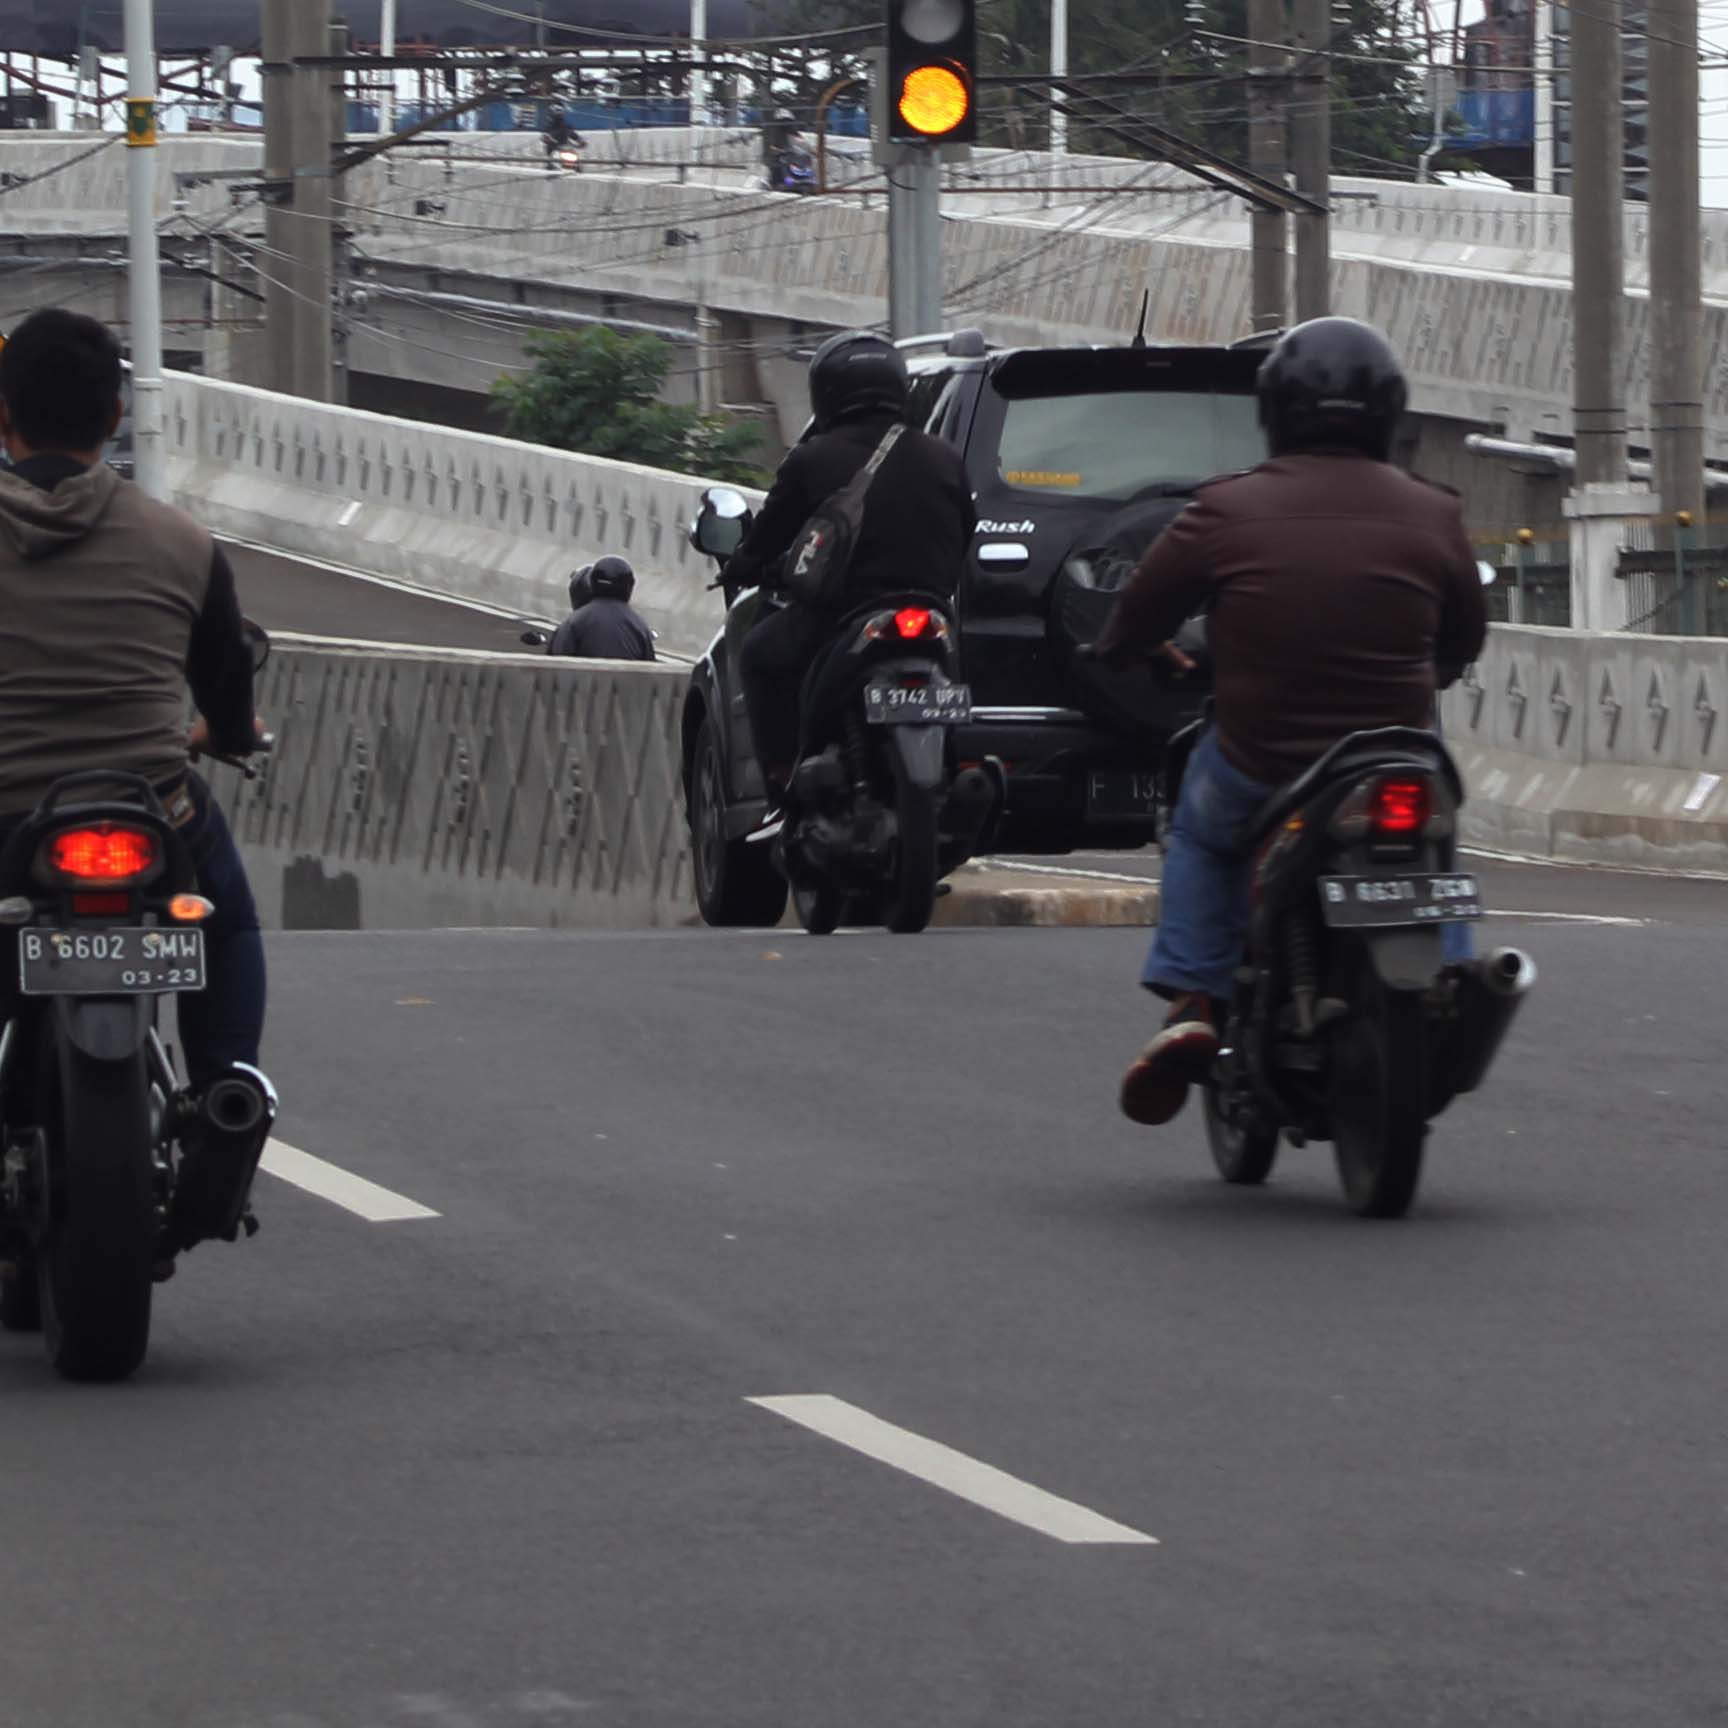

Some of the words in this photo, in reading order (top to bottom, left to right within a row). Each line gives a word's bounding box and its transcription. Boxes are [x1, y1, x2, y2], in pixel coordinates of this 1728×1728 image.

[974, 519, 1036, 534] Rush
[25, 934, 42, 960] B
[56, 934, 125, 960] 6602
[141, 933, 198, 959] SMW
